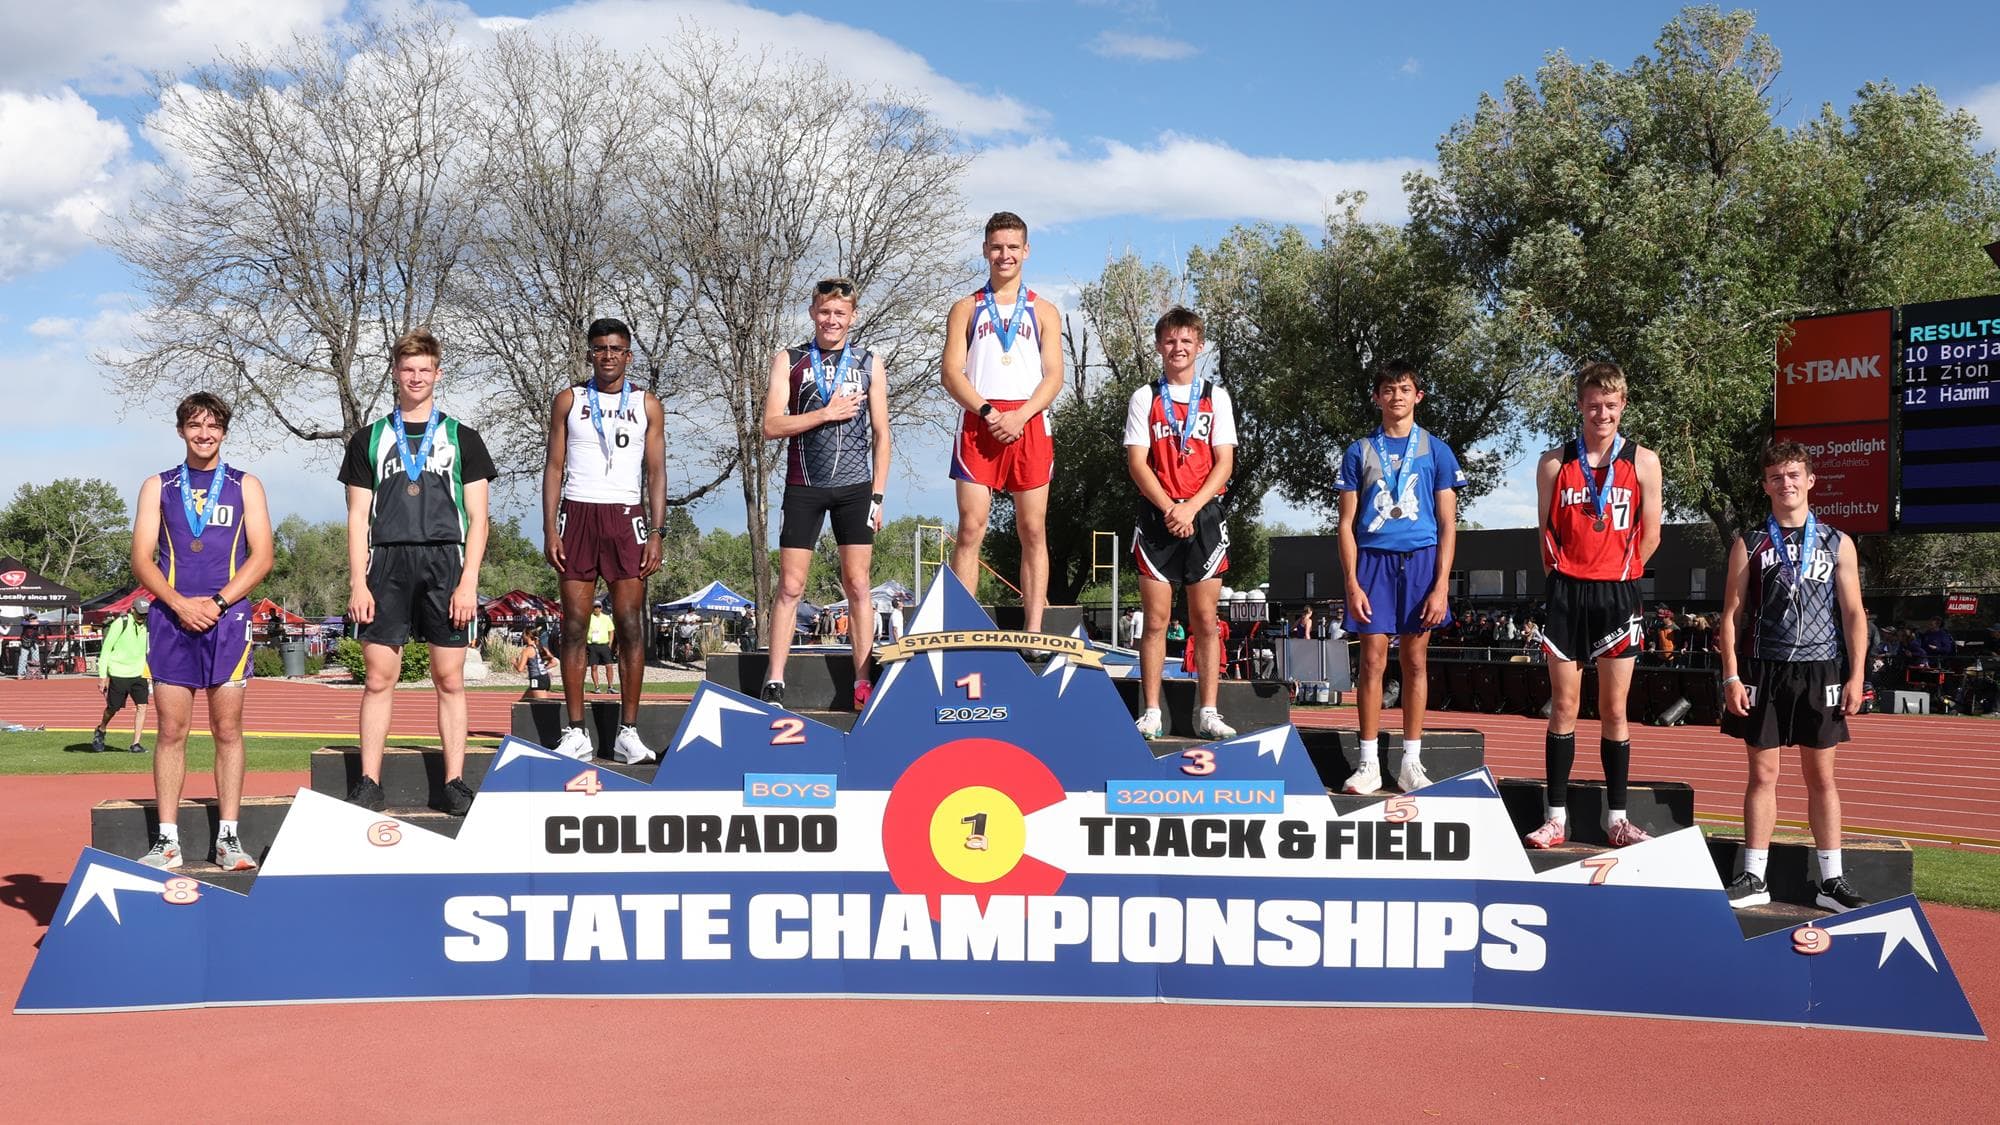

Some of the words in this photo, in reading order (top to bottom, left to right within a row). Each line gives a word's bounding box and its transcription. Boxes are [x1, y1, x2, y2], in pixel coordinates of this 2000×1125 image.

[1910, 319, 2000, 343] RESULTS
[1906, 345, 1928, 363] 10
[1905, 366, 1928, 383] 11
[1940, 361, 1989, 380] Zion
[1905, 388, 1926, 405] 12
[1939, 386, 1990, 403] Hamm
[614, 426, 630, 449] 6
[1198, 414, 1211, 437] 3
[1827, 438, 1886, 457] Spotlight
[1614, 503, 1628, 528] 7
[1809, 560, 1829, 581] 12
[1947, 603, 1975, 611] ALLOWED
[904, 633, 966, 648] STATE
[971, 632, 1078, 650] CHAMPION
[955, 672, 984, 700] 1
[938, 705, 1009, 723] 2025
[769, 717, 807, 746] 2
[1179, 748, 1217, 777] 3
[563, 768, 603, 797] 4
[751, 782, 832, 798] BOYS
[1116, 789, 1205, 805] 3200M
[1213, 789, 1276, 805] RUN
[1382, 795, 1420, 824] 5
[366, 820, 403, 848] 6
[544, 814, 838, 855] COLORADO
[1079, 816, 1267, 859] TRACK
[1277, 819, 1317, 860] &
[1325, 820, 1471, 862] FIELD
[1580, 857, 1620, 886] 7
[162, 877, 202, 906] 8
[444, 894, 732, 962] STATE
[748, 893, 1547, 972] CHAMPIONSHIPS
[1791, 926, 1832, 956] 9
